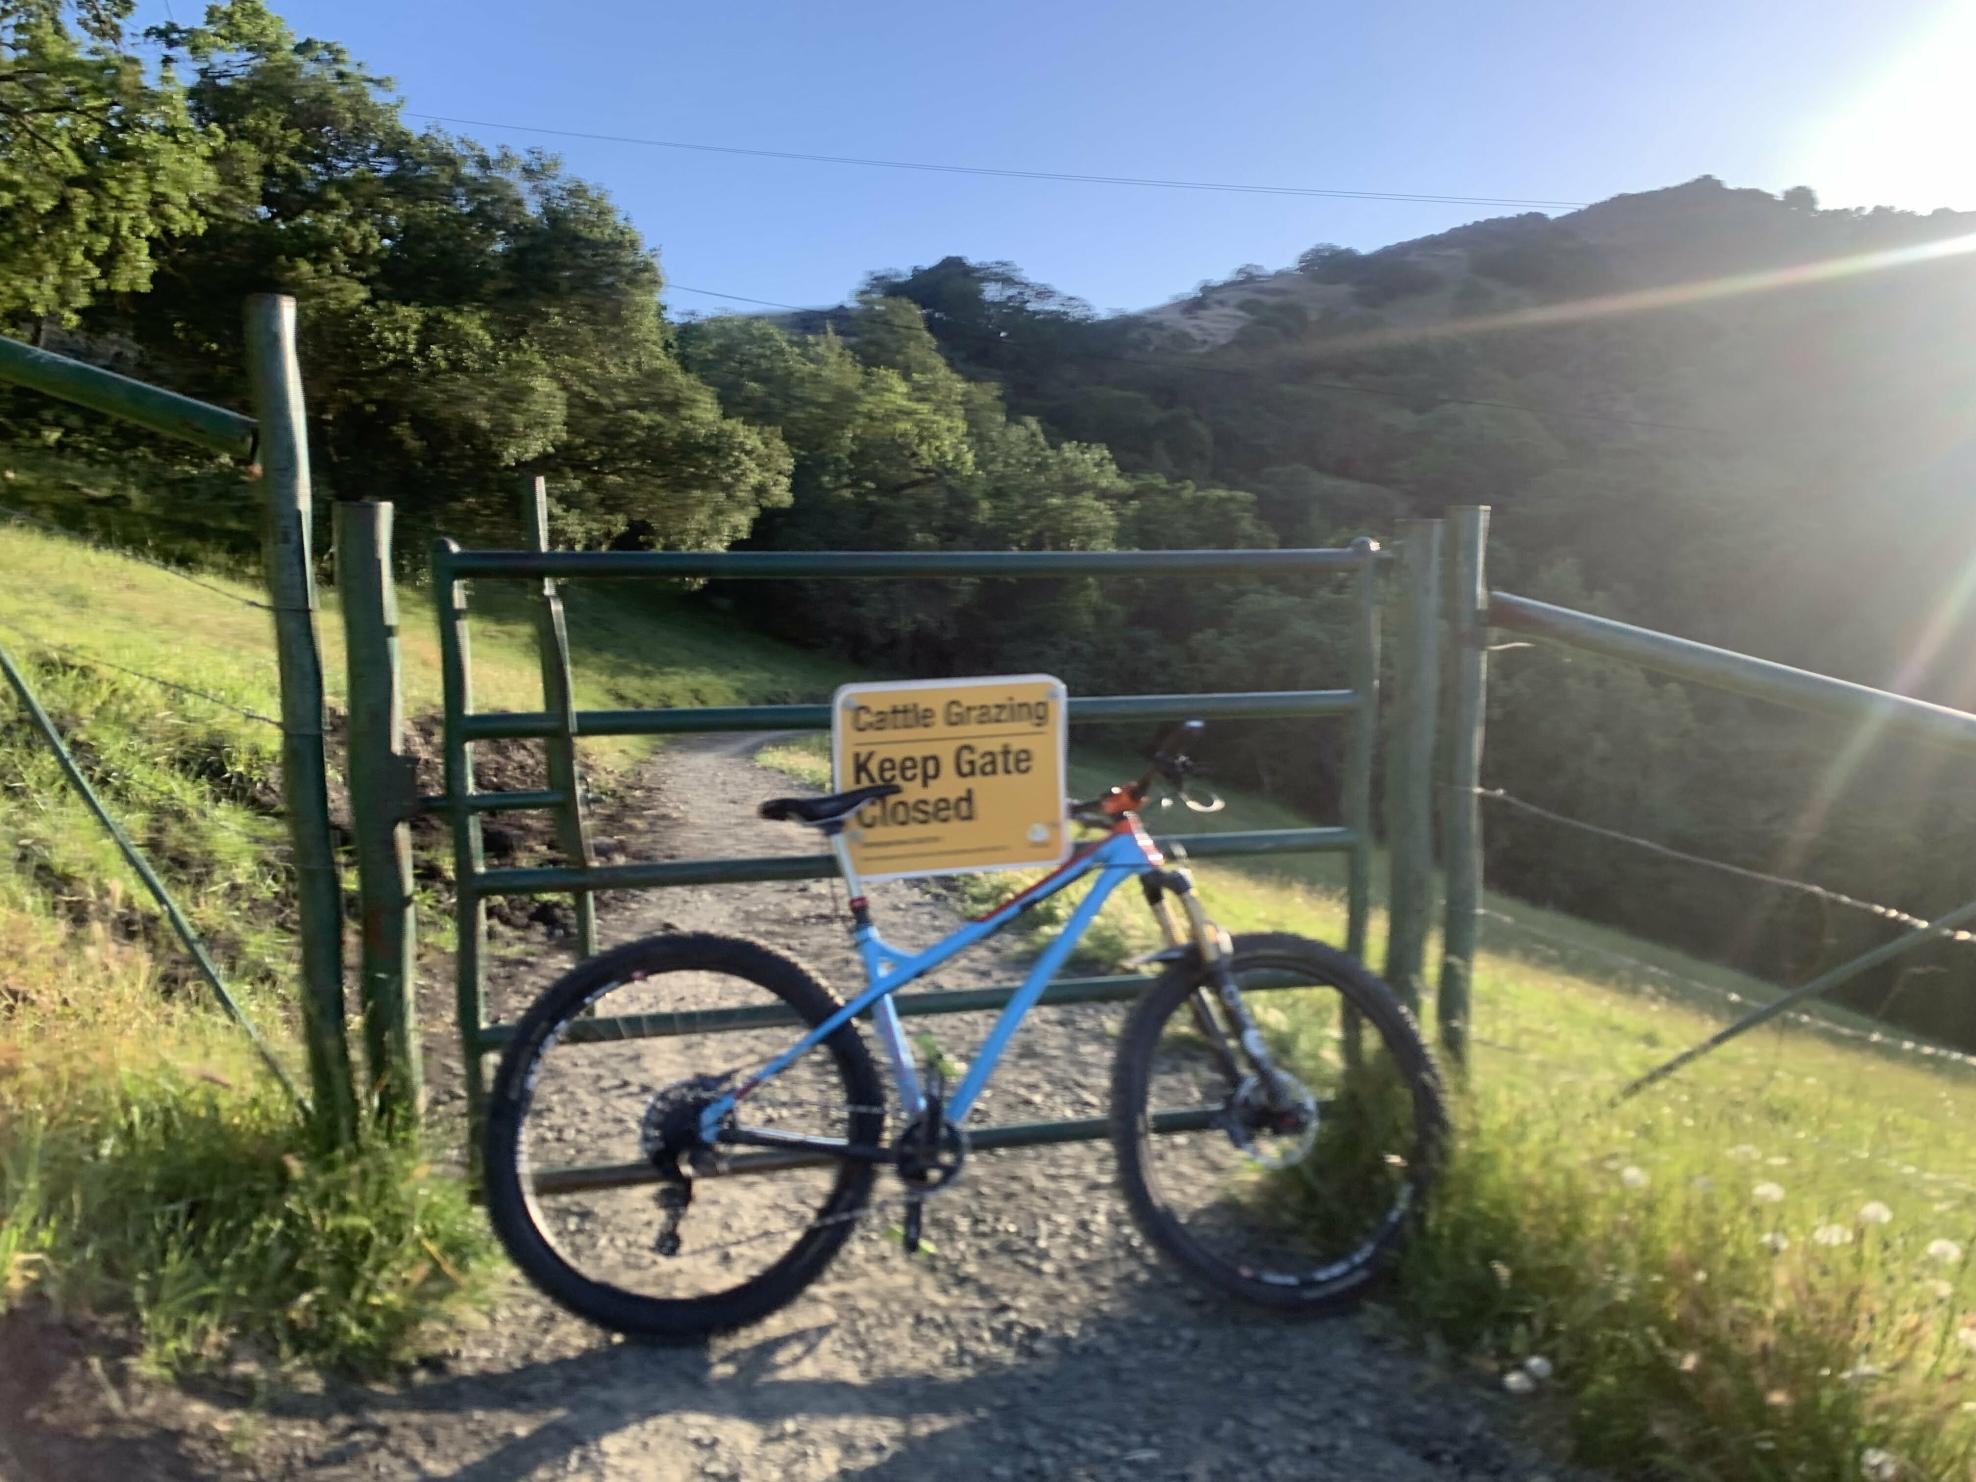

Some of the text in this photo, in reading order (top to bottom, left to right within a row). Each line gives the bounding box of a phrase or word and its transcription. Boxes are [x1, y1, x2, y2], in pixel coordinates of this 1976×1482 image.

[853, 697, 1049, 731] Cattle Grazing
[854, 744, 1033, 788] Keep Gate
